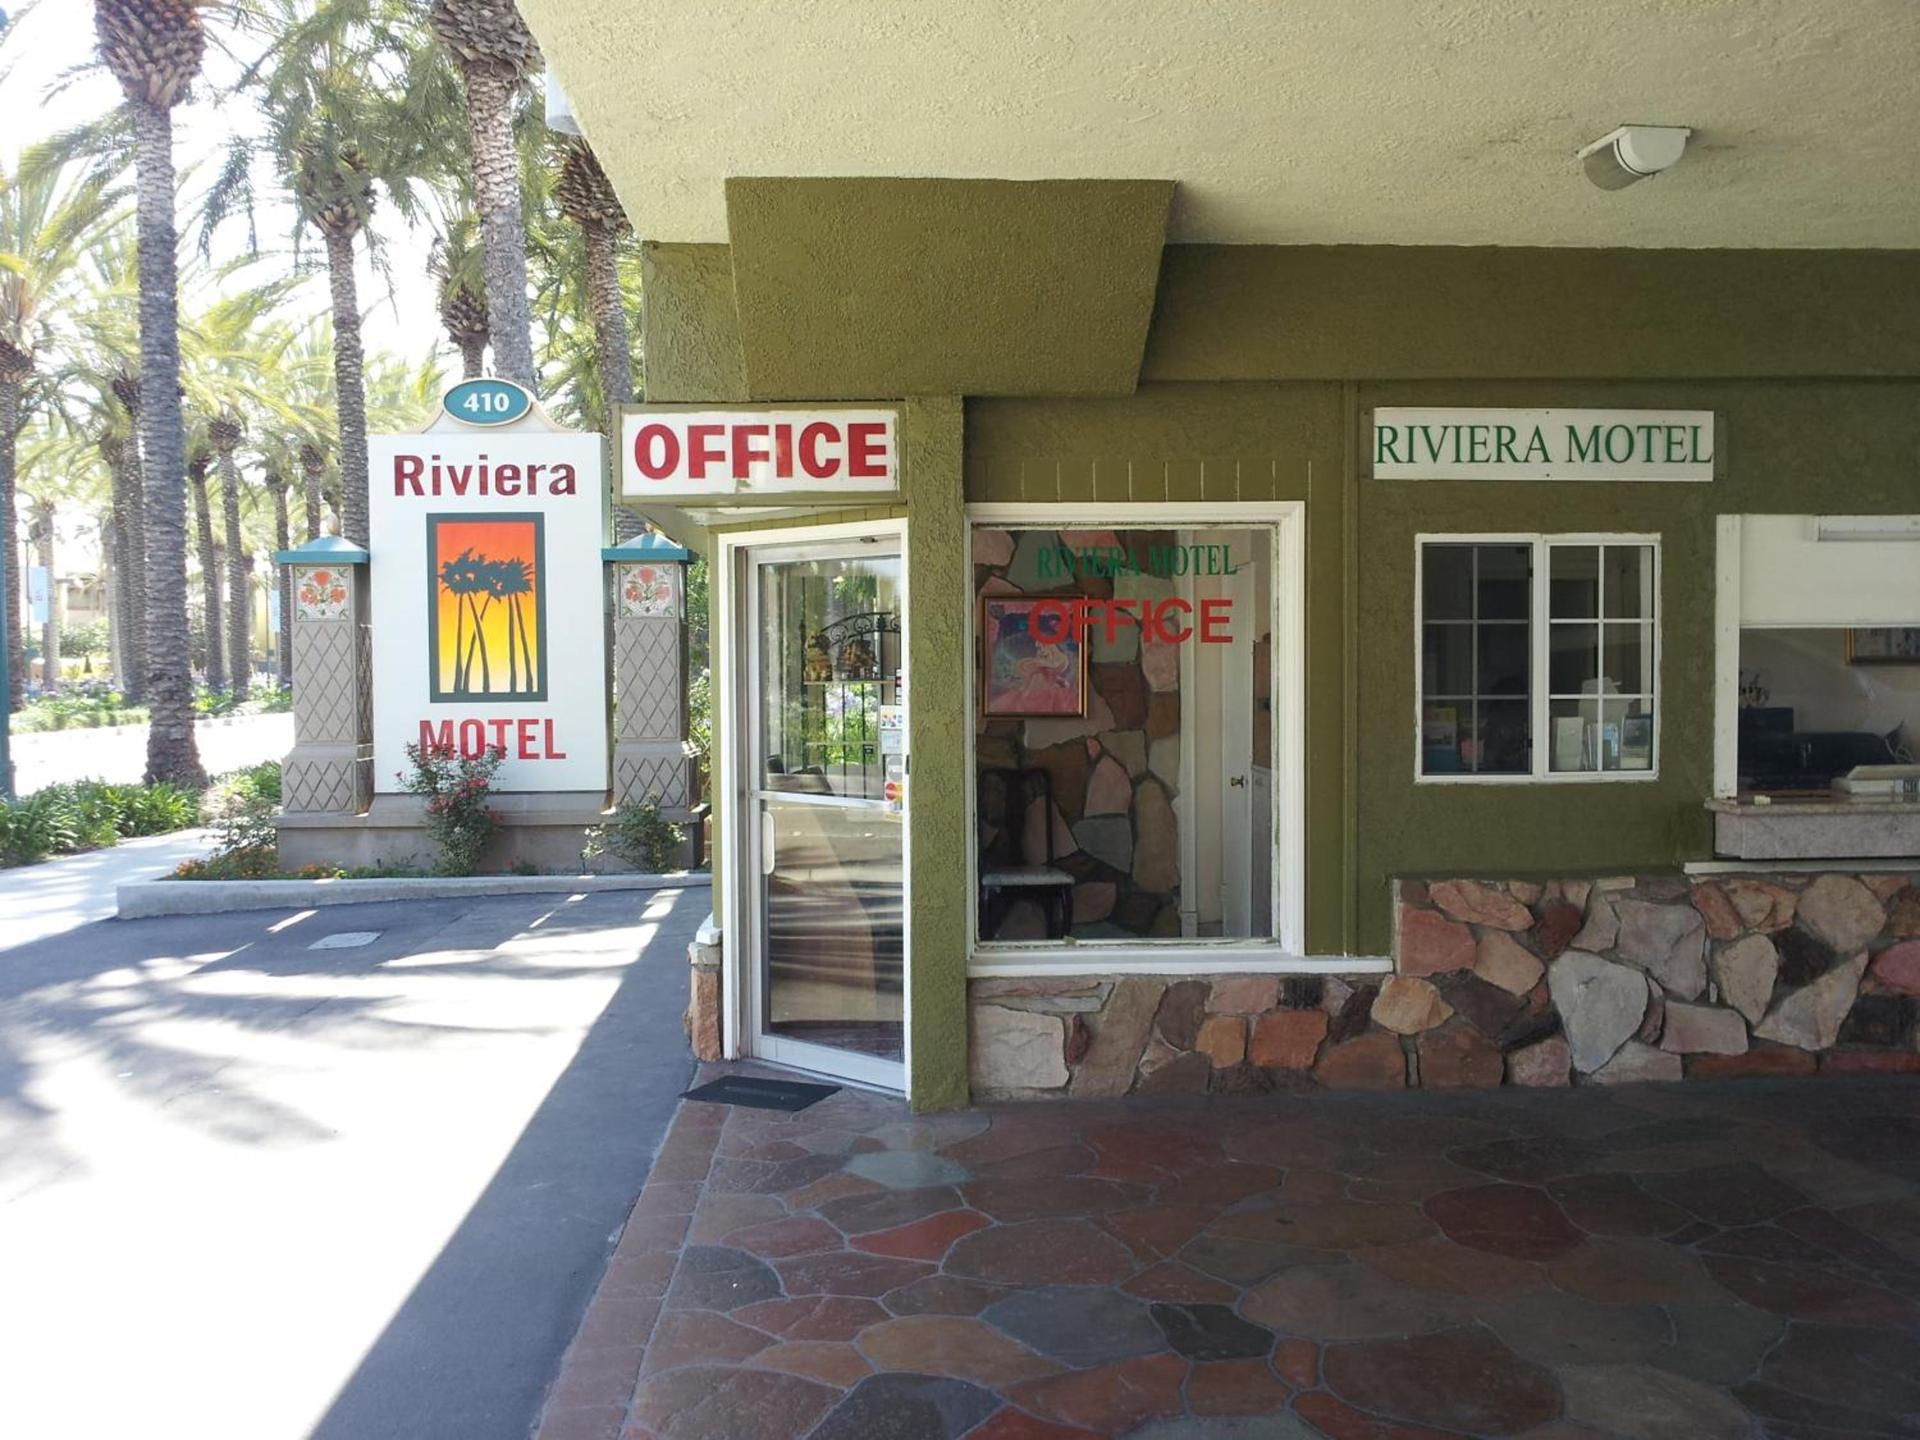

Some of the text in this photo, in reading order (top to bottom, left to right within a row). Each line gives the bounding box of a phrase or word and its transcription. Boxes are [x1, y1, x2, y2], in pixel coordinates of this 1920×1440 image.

[463, 392, 510, 413] 410
[634, 421, 888, 481] OFFICE
[1375, 424, 1713, 464] RIVIERA MOTEL
[393, 454, 577, 496] Riviera
[1036, 545, 1236, 578] RIVIERA MOTEL
[1028, 597, 1233, 645] OFFICE
[419, 718, 567, 762] MOTEL
